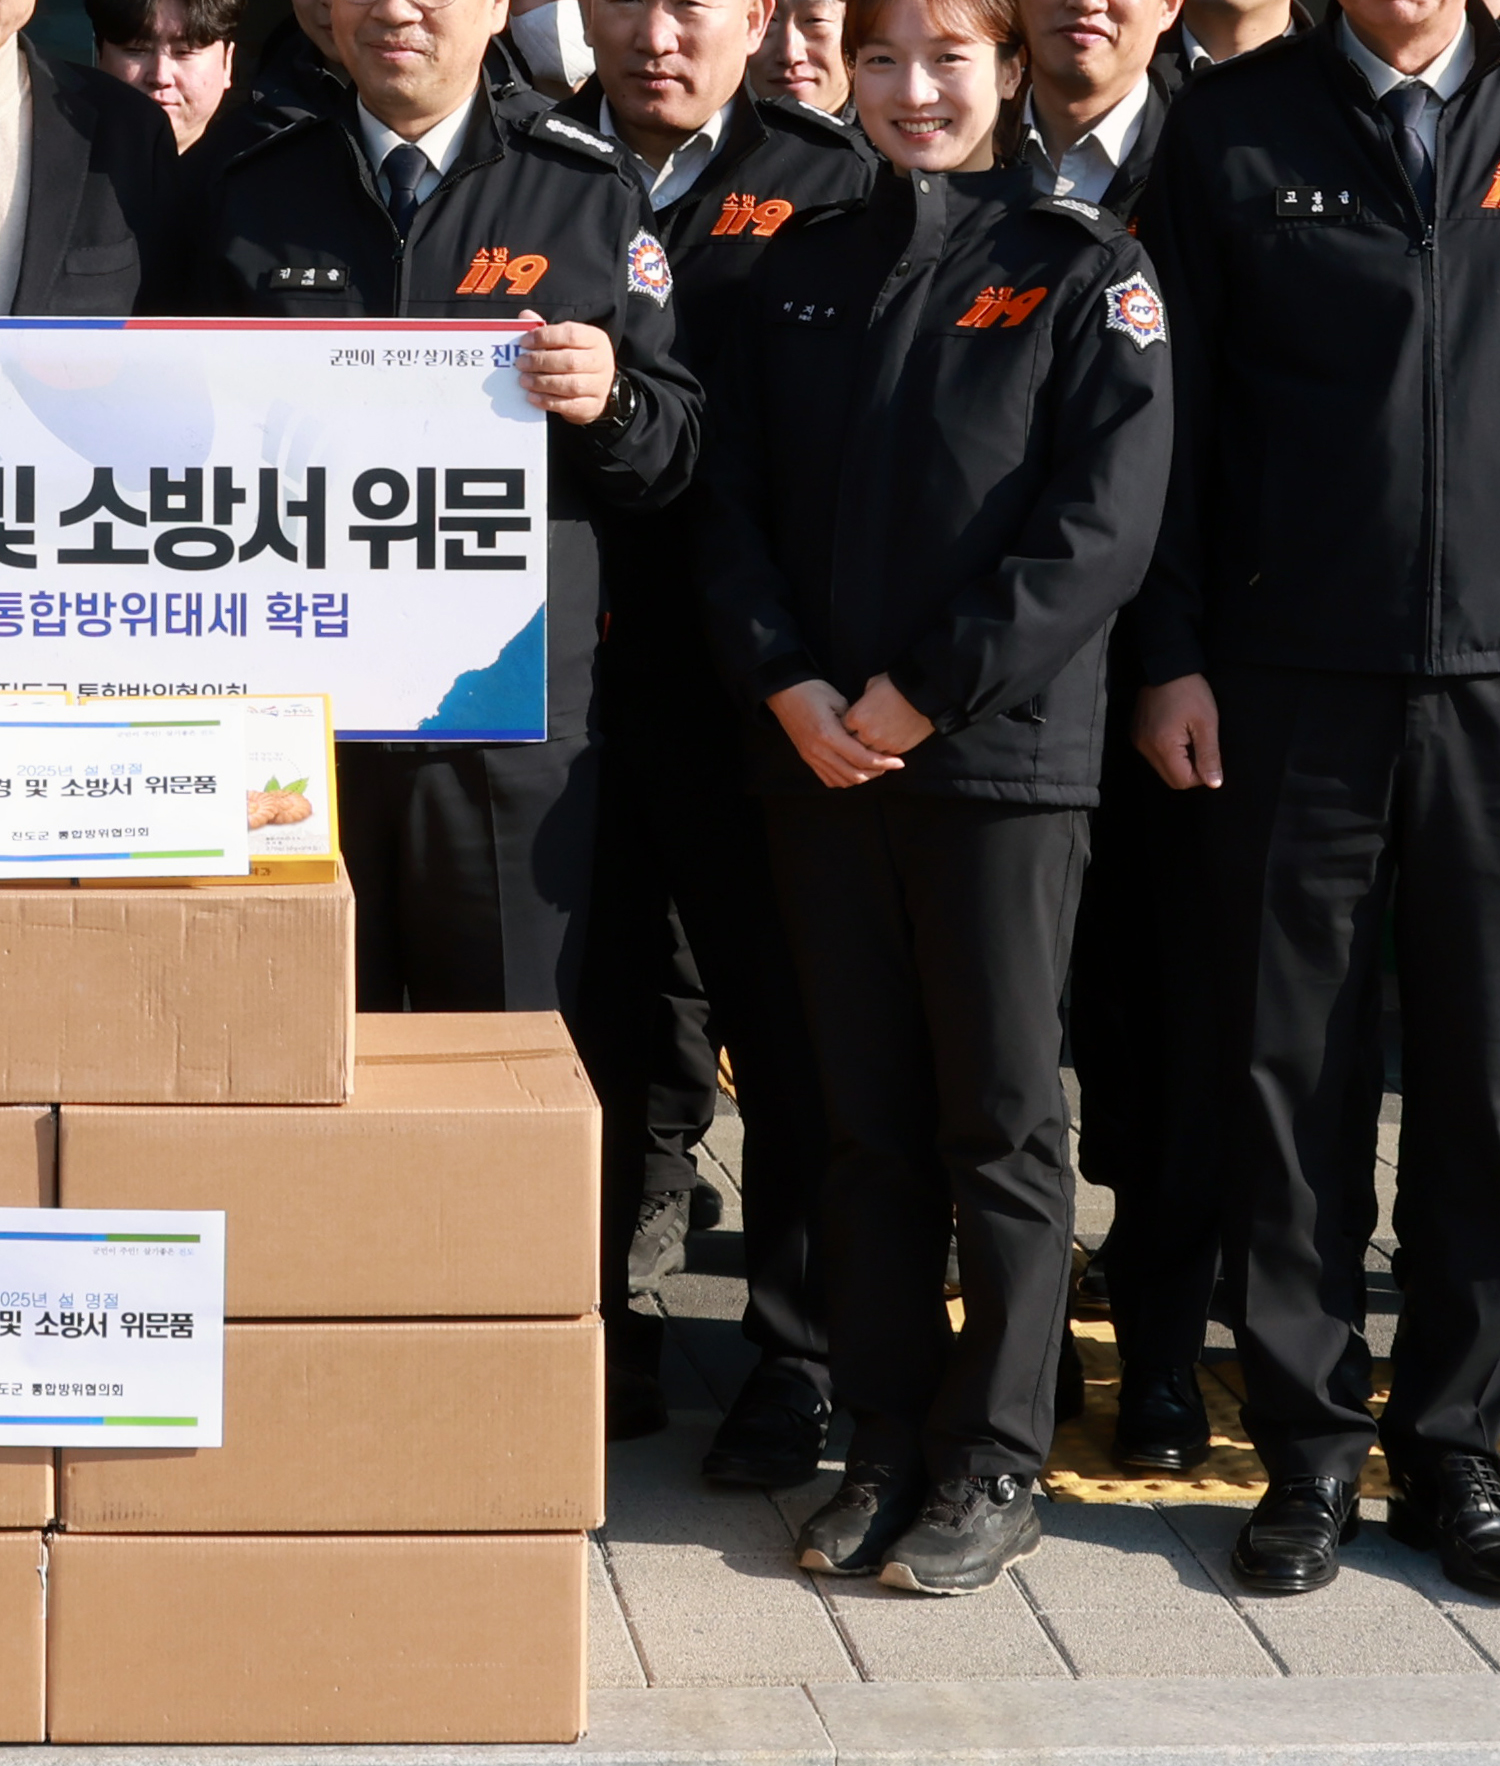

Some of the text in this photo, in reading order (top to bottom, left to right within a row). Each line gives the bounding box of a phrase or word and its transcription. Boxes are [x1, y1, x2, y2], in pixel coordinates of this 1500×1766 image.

[721, 191, 757, 208] 소방
[710, 199, 793, 237] 119
[471, 246, 509, 263] 소방
[454, 254, 549, 295] 119
[973, 285, 1014, 302] 소방
[954, 286, 1048, 328] 119
[330, 349, 375, 366] 군민이
[384, 349, 420, 366] 주인!
[424, 349, 484, 367] 살기좋은
[57, 466, 327, 572] 소방서
[348, 466, 532, 571] 위문
[267, 592, 348, 637] 확립
[16, 763, 143, 777] 2025년 설 명절
[25, 779, 48, 798] 및
[62, 777, 132, 798] 소방서
[145, 775, 217, 795] 위문품
[11, 827, 149, 841] 진도군 통합방위협의회
[58, 1292, 74, 1309] 설
[85, 1293, 119, 1310] 명절
[0, 1310, 22, 1337] 및
[34, 1311, 108, 1339] 소방서
[120, 1312, 194, 1339] 위문품
[32, 1383, 123, 1397] 통합방위협의회
